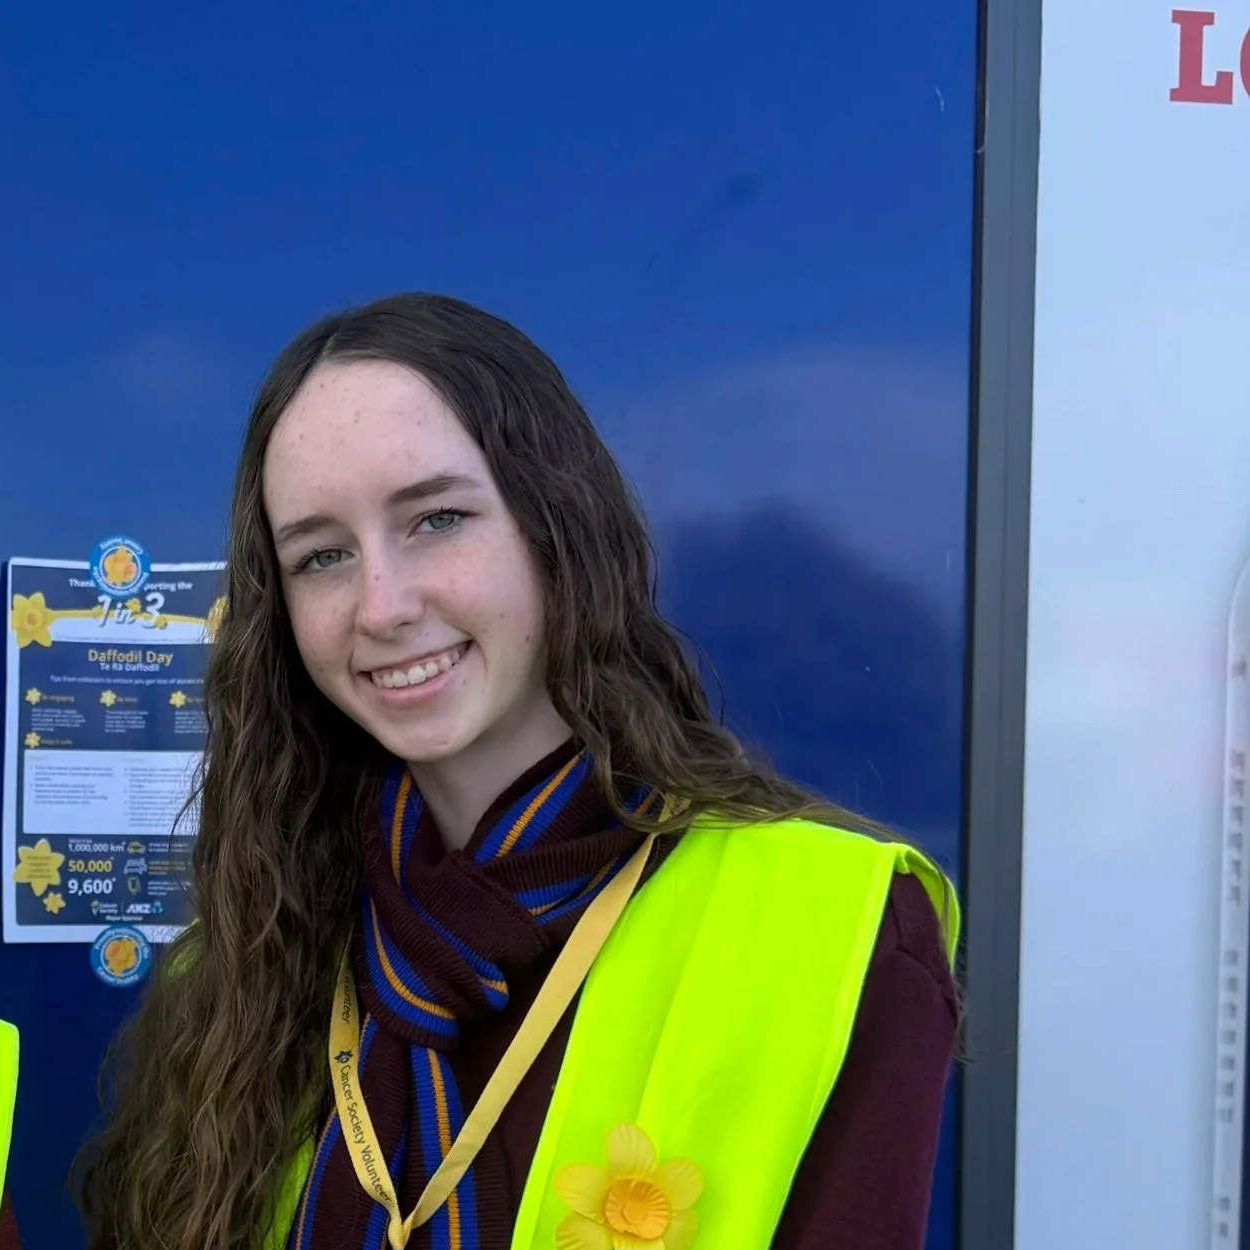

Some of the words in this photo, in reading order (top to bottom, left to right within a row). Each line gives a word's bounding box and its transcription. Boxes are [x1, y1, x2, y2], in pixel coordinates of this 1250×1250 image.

[1170, 10, 1250, 105] L
[142, 592, 166, 629] 3
[88, 650, 142, 664] Daffodil
[147, 651, 173, 667] Day
[100, 663, 110, 671] Te
[125, 664, 160, 672] Daffodil
[68, 843, 109, 853] 1,000,000
[340, 1064, 353, 1101] Cancer
[347, 1102, 365, 1145] Society
[360, 1144, 391, 1202] Volunteer
